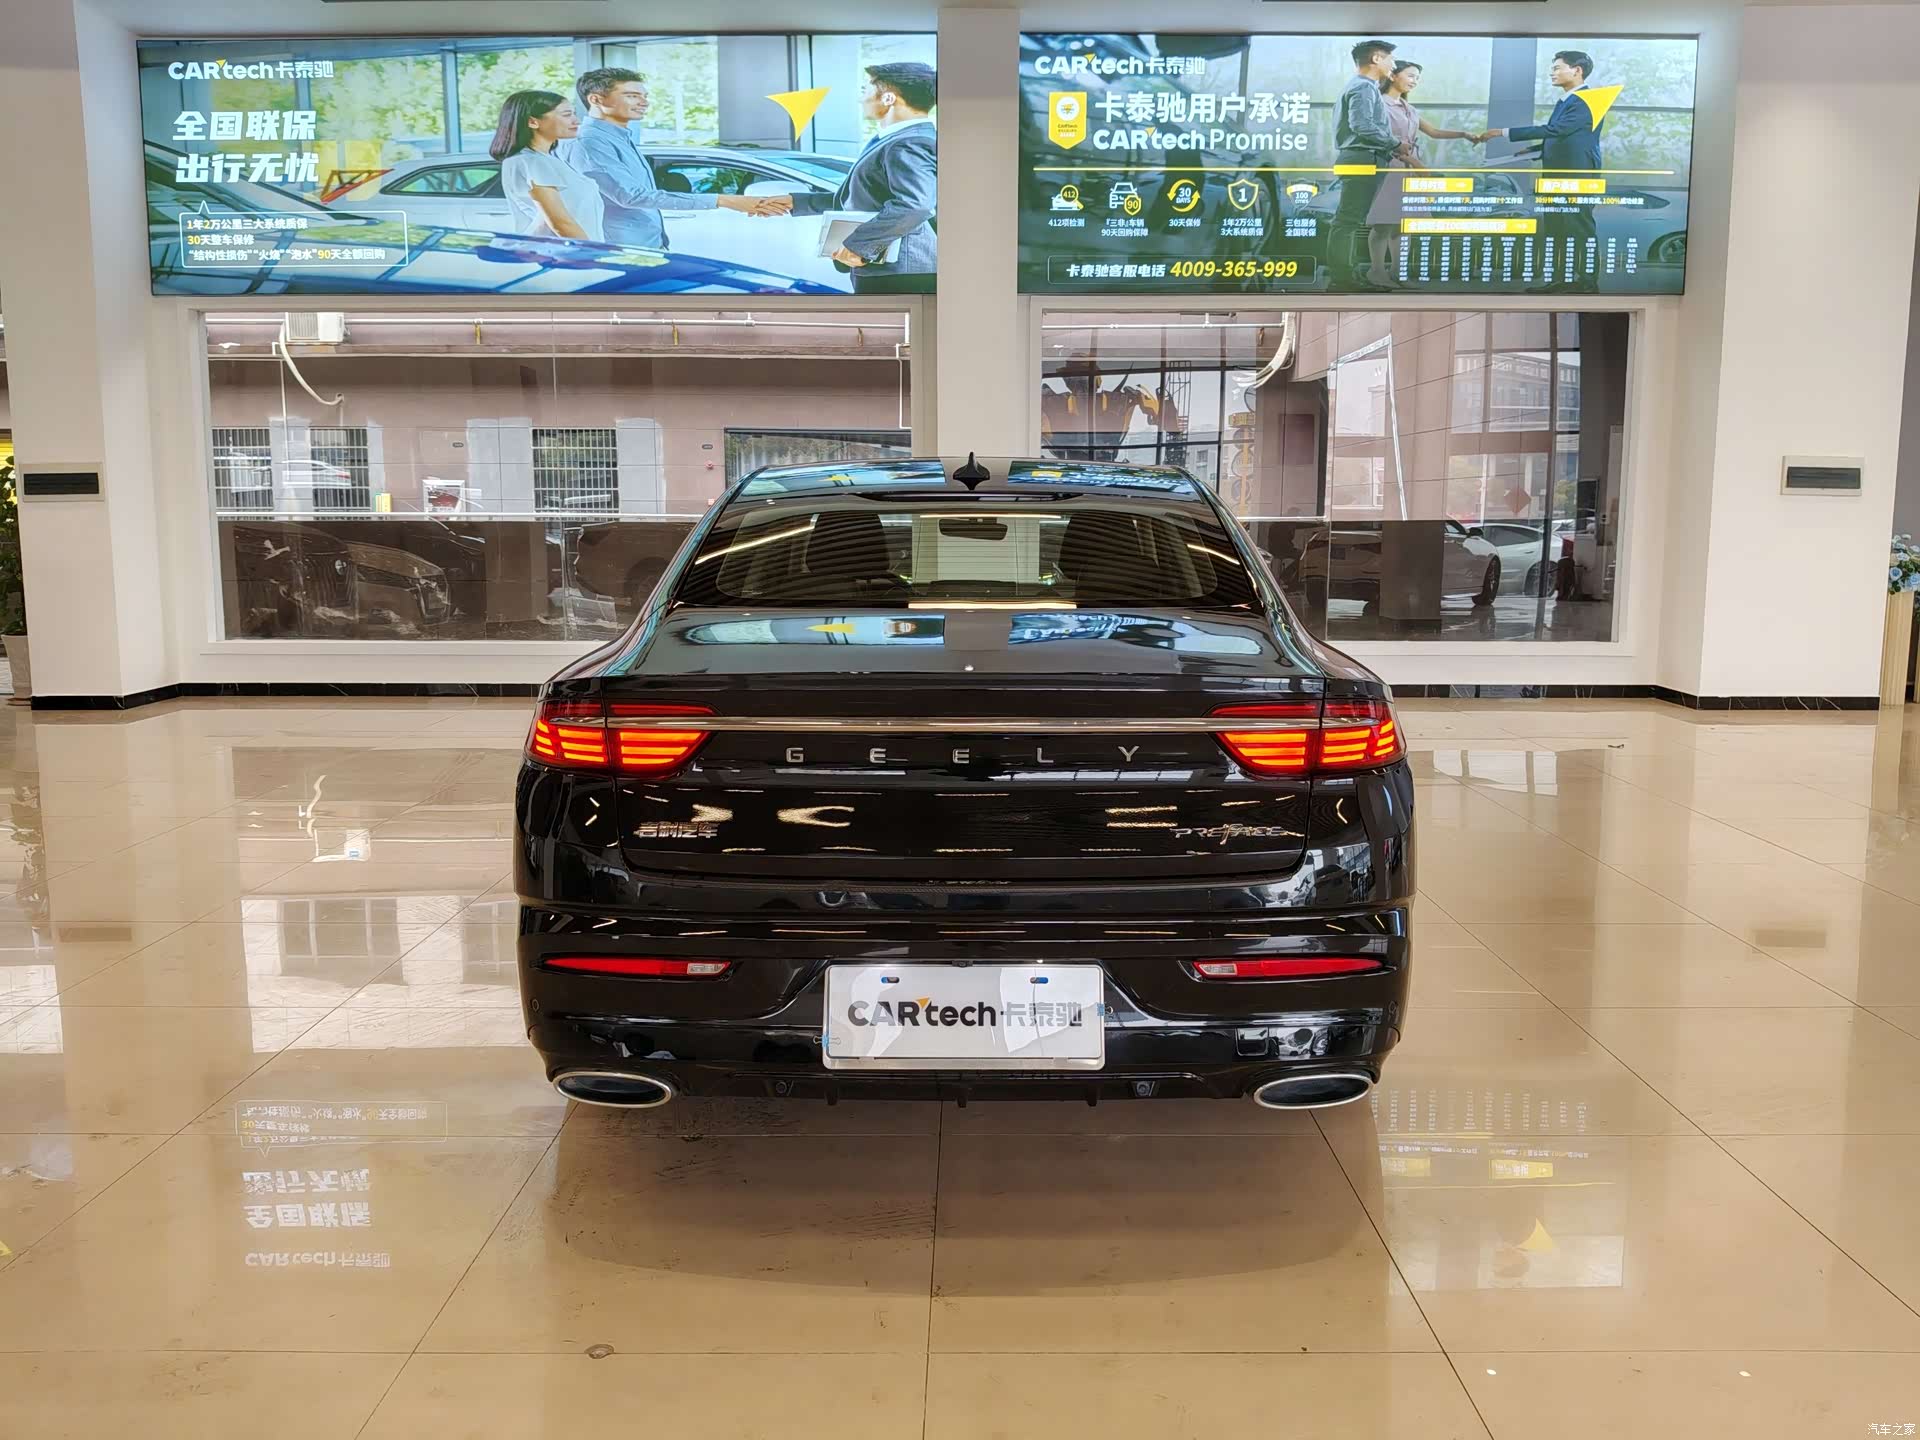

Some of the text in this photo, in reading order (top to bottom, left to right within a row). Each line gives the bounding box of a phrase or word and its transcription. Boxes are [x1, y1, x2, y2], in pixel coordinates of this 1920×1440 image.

[1095, 91, 1311, 124] 卡泰驰用户承诺
[172, 110, 317, 141] 全国联保
[1093, 127, 1206, 150] CARtech
[1209, 127, 1308, 150] Promise
[175, 152, 320, 183] 出行无忧
[1063, 190, 1076, 198] 412
[1178, 187, 1192, 197] 30
[1238, 188, 1248, 203] 1
[1127, 201, 1138, 210] 90
[186, 218, 309, 230] 1年2万公里三大系统质保
[1048, 218, 1085, 227] 412项检测
[1168, 218, 1201, 227] 30天保修
[1222, 218, 1263, 227] 1年2万公里
[1220, 228, 1264, 237] 3大系统质保
[1285, 228, 1317, 237] 全国联保
[187, 234, 254, 246] 30天整车保修
[1066, 261, 1298, 278] 卡泰驰客服电话 4009-365-999
[785, 746, 1140, 765] GEELY
[848, 998, 1083, 1027] CARtech 卡泰驰
